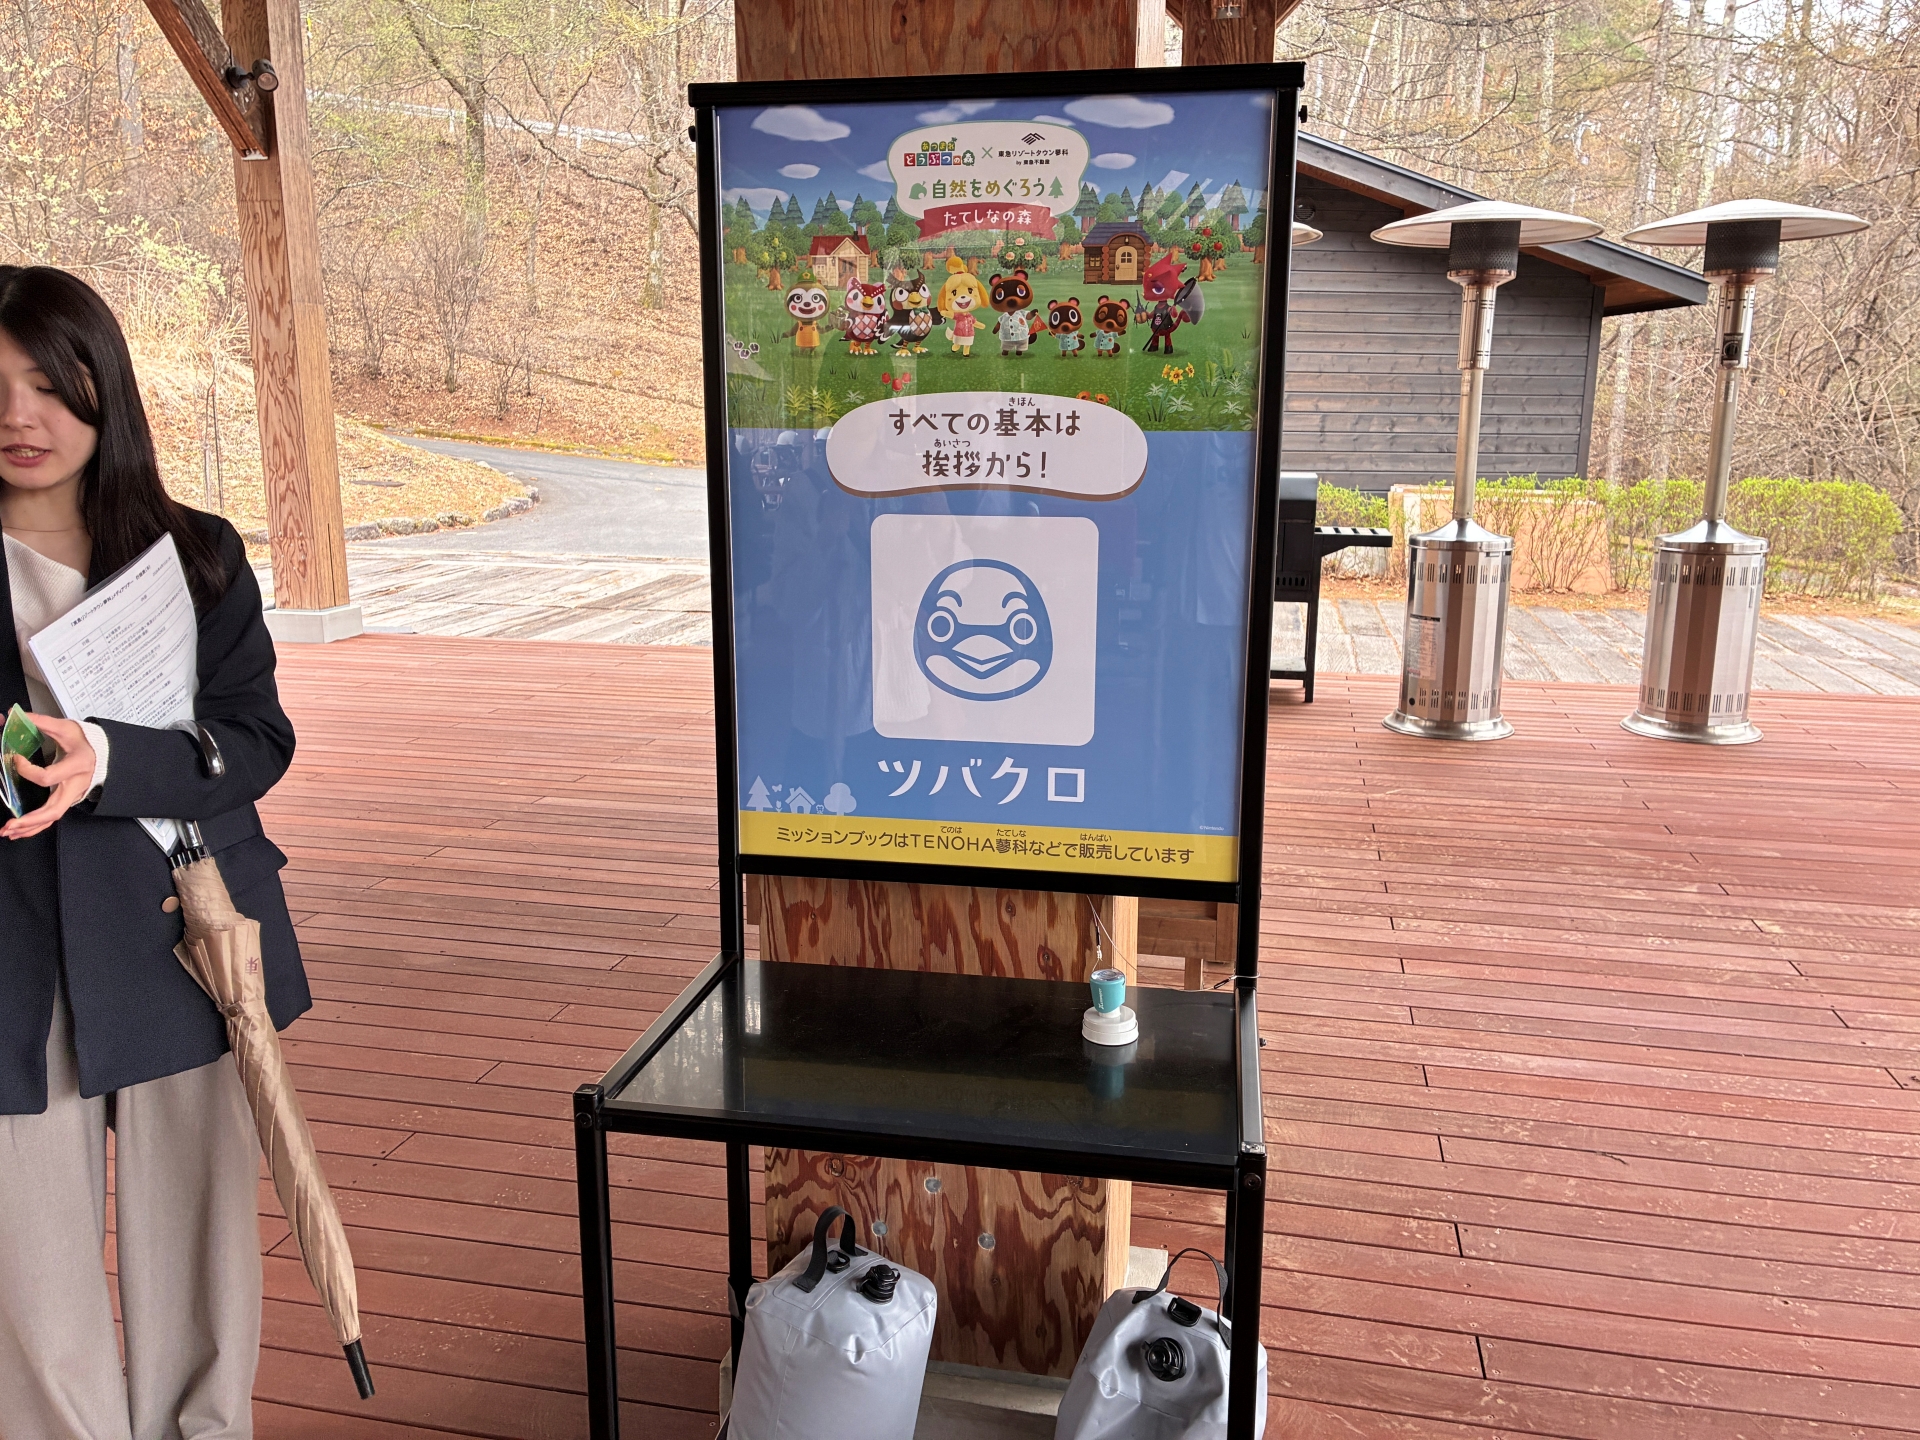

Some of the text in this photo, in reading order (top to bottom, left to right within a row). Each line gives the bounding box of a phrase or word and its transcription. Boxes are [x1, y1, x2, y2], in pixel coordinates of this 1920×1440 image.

[921, 139, 956, 152] あつまれ
[904, 150, 975, 166] どうぶつの森
[932, 177, 1045, 199] 自然をめぐろう
[943, 208, 1032, 226] たてしなの森
[1008, 396, 1036, 407] きほん
[888, 408, 1081, 438] すべての基本は
[933, 438, 971, 449] あいさつ
[877, 756, 1086, 805] ツバクロ
[940, 825, 1112, 842] てのは たてしな はんばい
[776, 826, 1195, 865] ミッションブックはTENOHA蓼科などで販売しています
